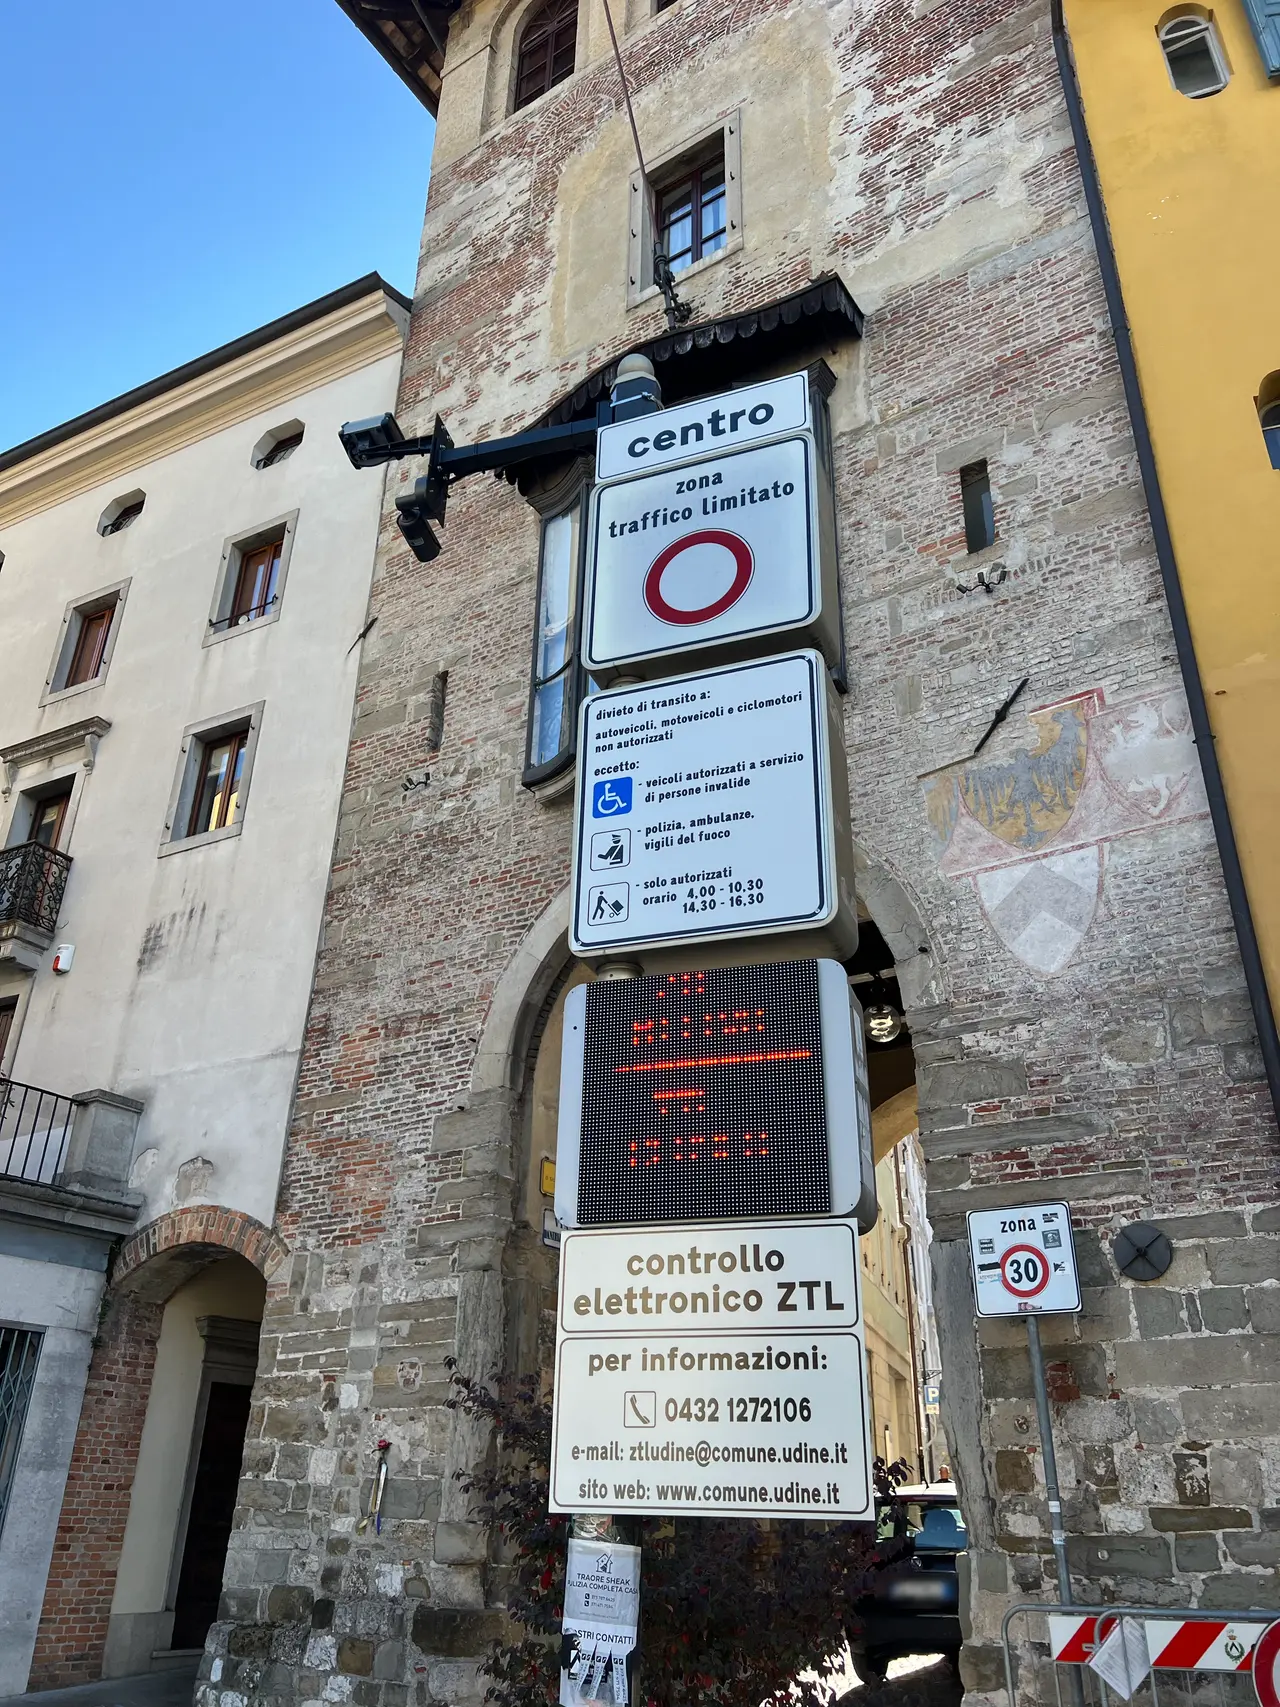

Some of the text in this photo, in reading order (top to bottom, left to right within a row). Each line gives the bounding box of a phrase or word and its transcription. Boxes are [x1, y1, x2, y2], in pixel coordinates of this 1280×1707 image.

[627, 402, 774, 458] centro
[676, 472, 723, 494] zona
[609, 480, 794, 538] traffico limitato
[596, 691, 710, 720] divieto di transito a:
[662, 707, 723, 727] motoveicoli
[738, 691, 802, 712] ciclomotori
[596, 730, 673, 753] non autorizzati
[594, 761, 639, 776] eccetto:
[646, 772, 682, 787] veicoli
[686, 761, 745, 780] autorizzati
[760, 752, 803, 767] servizio
[645, 777, 750, 803] di persone invalide
[645, 830, 730, 851] vigili del fuoco
[644, 877, 666, 889] solo
[671, 866, 731, 885] autorizzati
[643, 892, 676, 905] orario
[1000, 1219, 1036, 1233] zona
[628, 1244, 784, 1275] controllo
[1010, 1258, 1038, 1283] 30
[574, 1281, 844, 1315] elettronico ZTL
[589, 1345, 827, 1376] per informazioni:
[665, 1397, 811, 1422] 0432 1272106
[572, 1441, 848, 1467] e-mail: ztludine@comune.udine.it
[579, 1478, 840, 1504] sito web: www.comune.udine.it
[577, 1573, 630, 1585] TRAORE SHEAK
[589, 1583, 623, 1593] COMPLETA
[596, 1633, 633, 1644] CONTATTI
